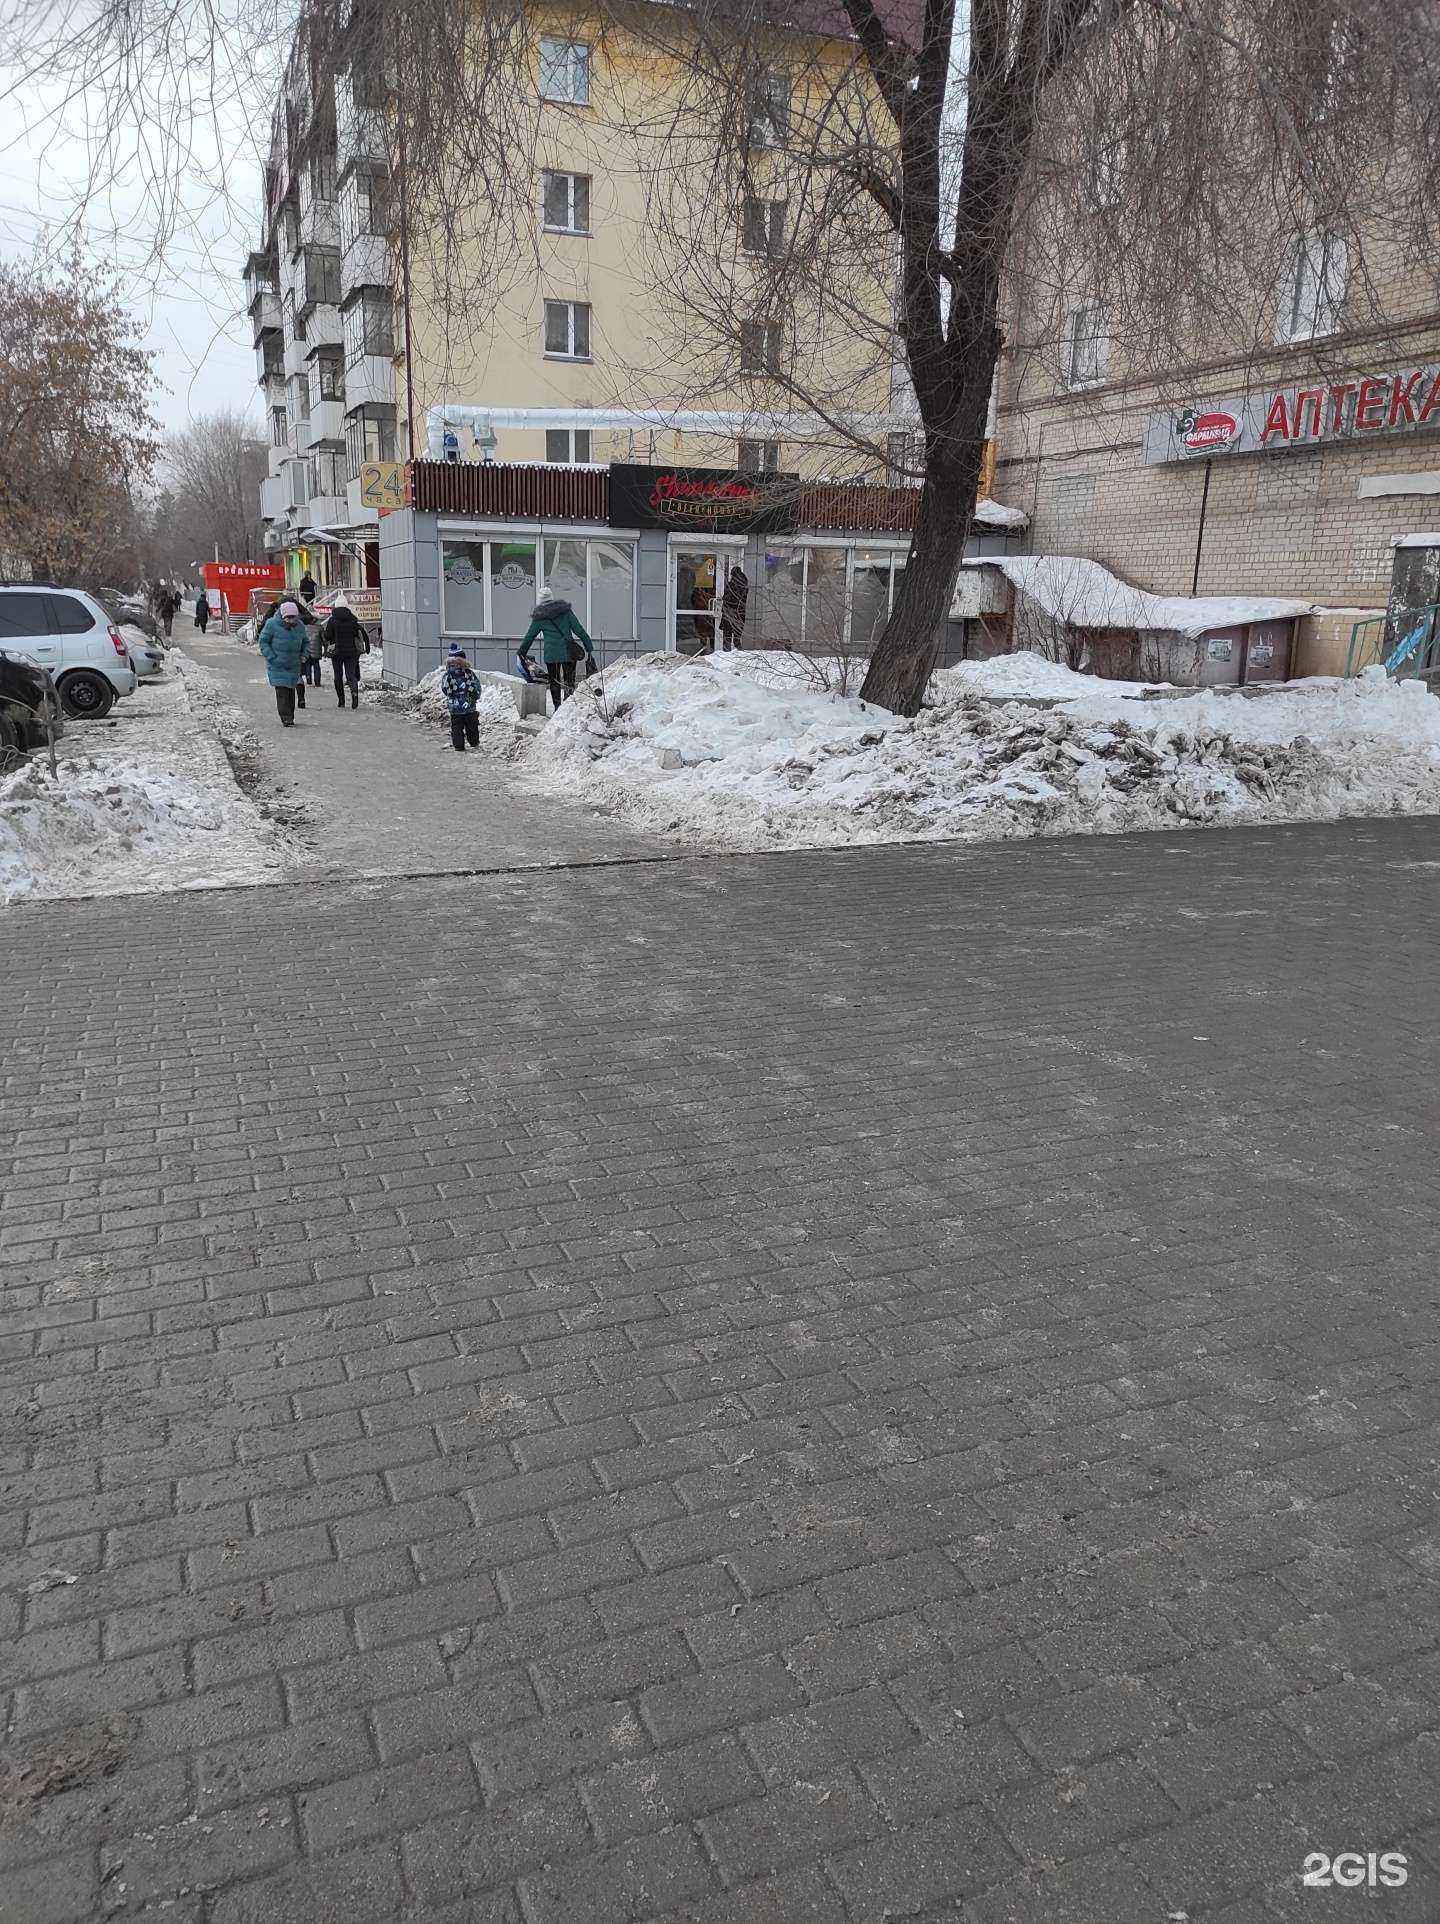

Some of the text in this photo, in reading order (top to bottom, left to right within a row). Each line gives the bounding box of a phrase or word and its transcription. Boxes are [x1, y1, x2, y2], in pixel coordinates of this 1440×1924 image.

[1259, 371, 1440, 442] АПТЕКА
[366, 467, 402, 496] 24
[218, 565, 270, 576] ПРОДУКТЫ
[351, 594, 380, 602] АТЕЛЬ
